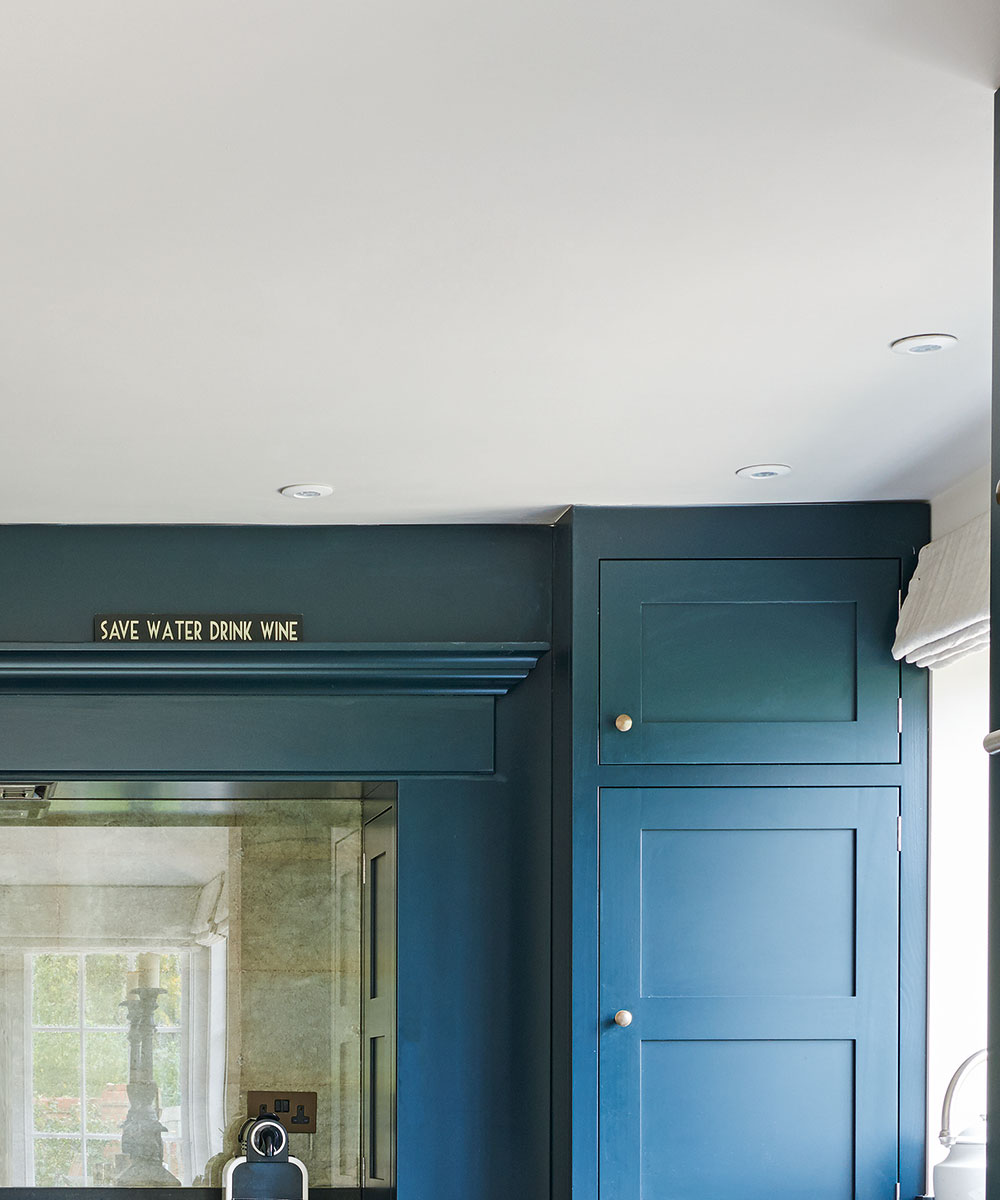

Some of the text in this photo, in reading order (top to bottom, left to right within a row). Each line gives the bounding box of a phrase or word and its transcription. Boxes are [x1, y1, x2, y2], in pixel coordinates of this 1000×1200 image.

[100, 620, 298, 641] SAVE WATER DRINK WINE
